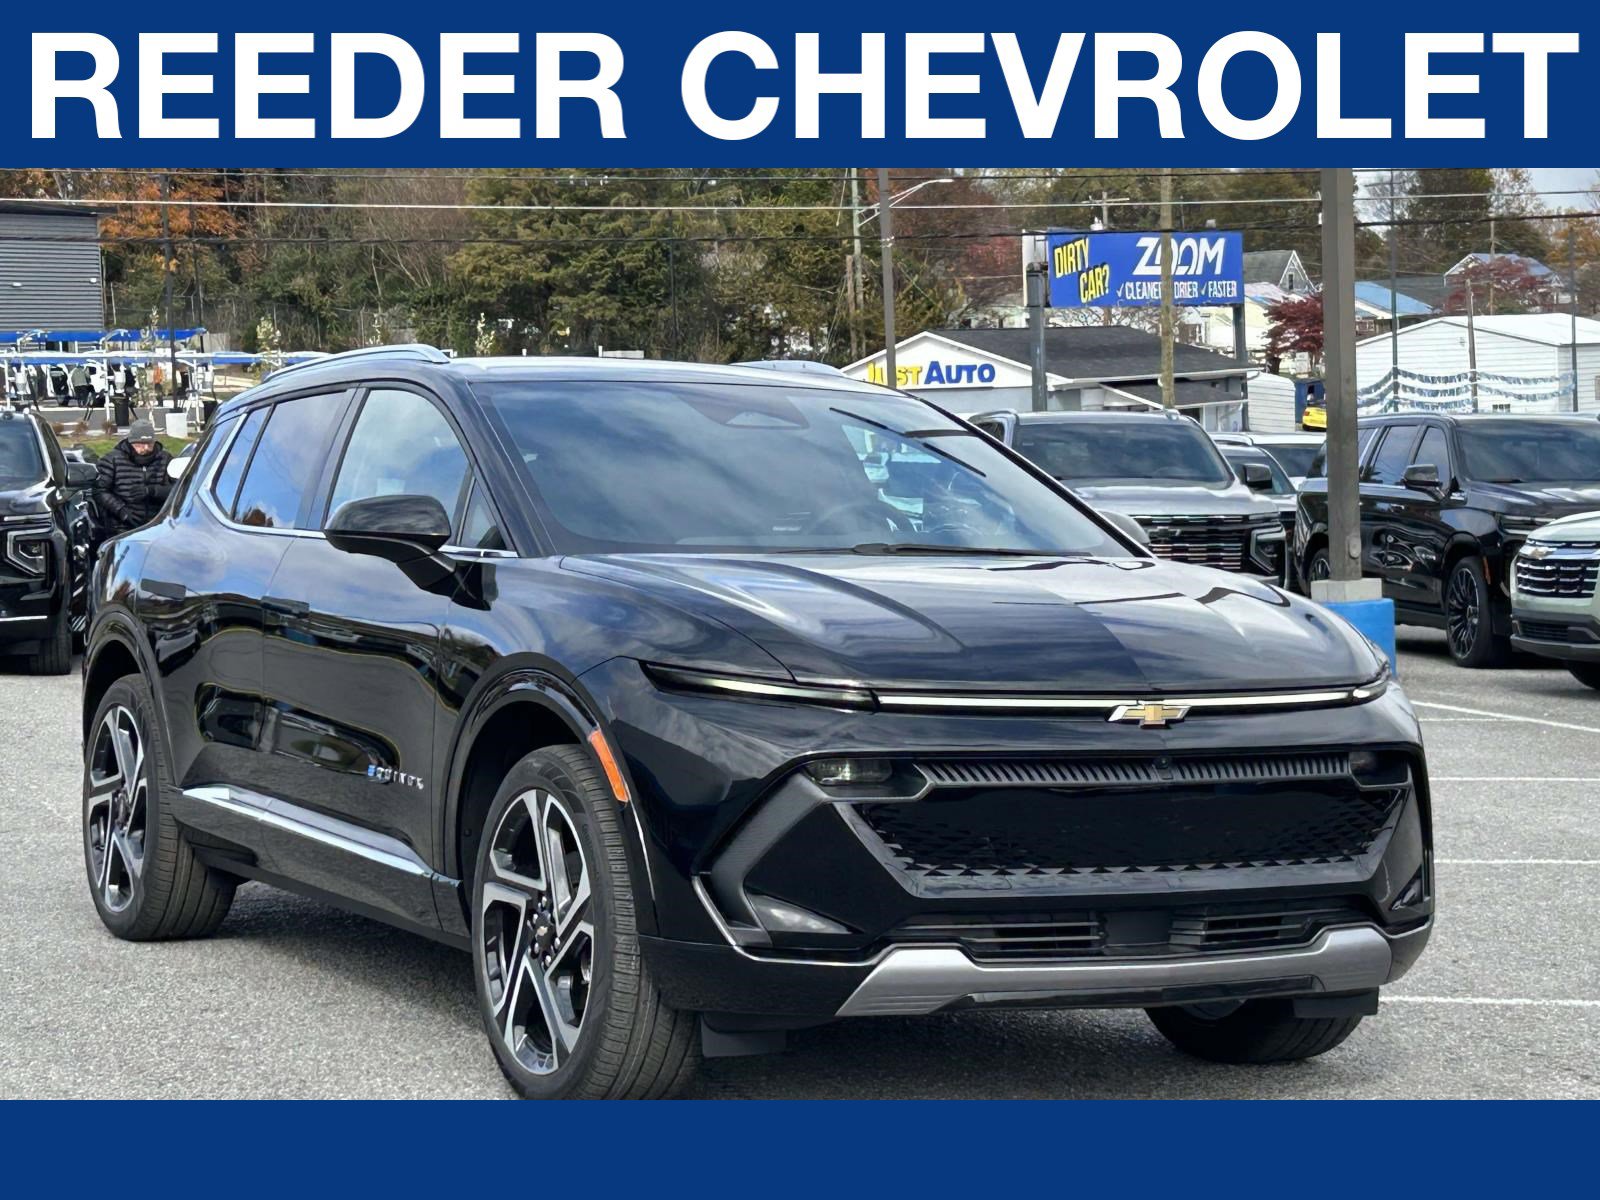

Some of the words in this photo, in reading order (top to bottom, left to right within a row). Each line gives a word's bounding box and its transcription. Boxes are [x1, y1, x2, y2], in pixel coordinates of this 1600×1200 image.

[1054, 237, 1089, 278] DIRTY
[1132, 237, 1226, 275] ZOOM
[1079, 264, 1110, 303] CAR?
[1174, 281, 1198, 298] DRIER
[1208, 280, 1238, 298] FASTER
[924, 360, 995, 384] AUTO
